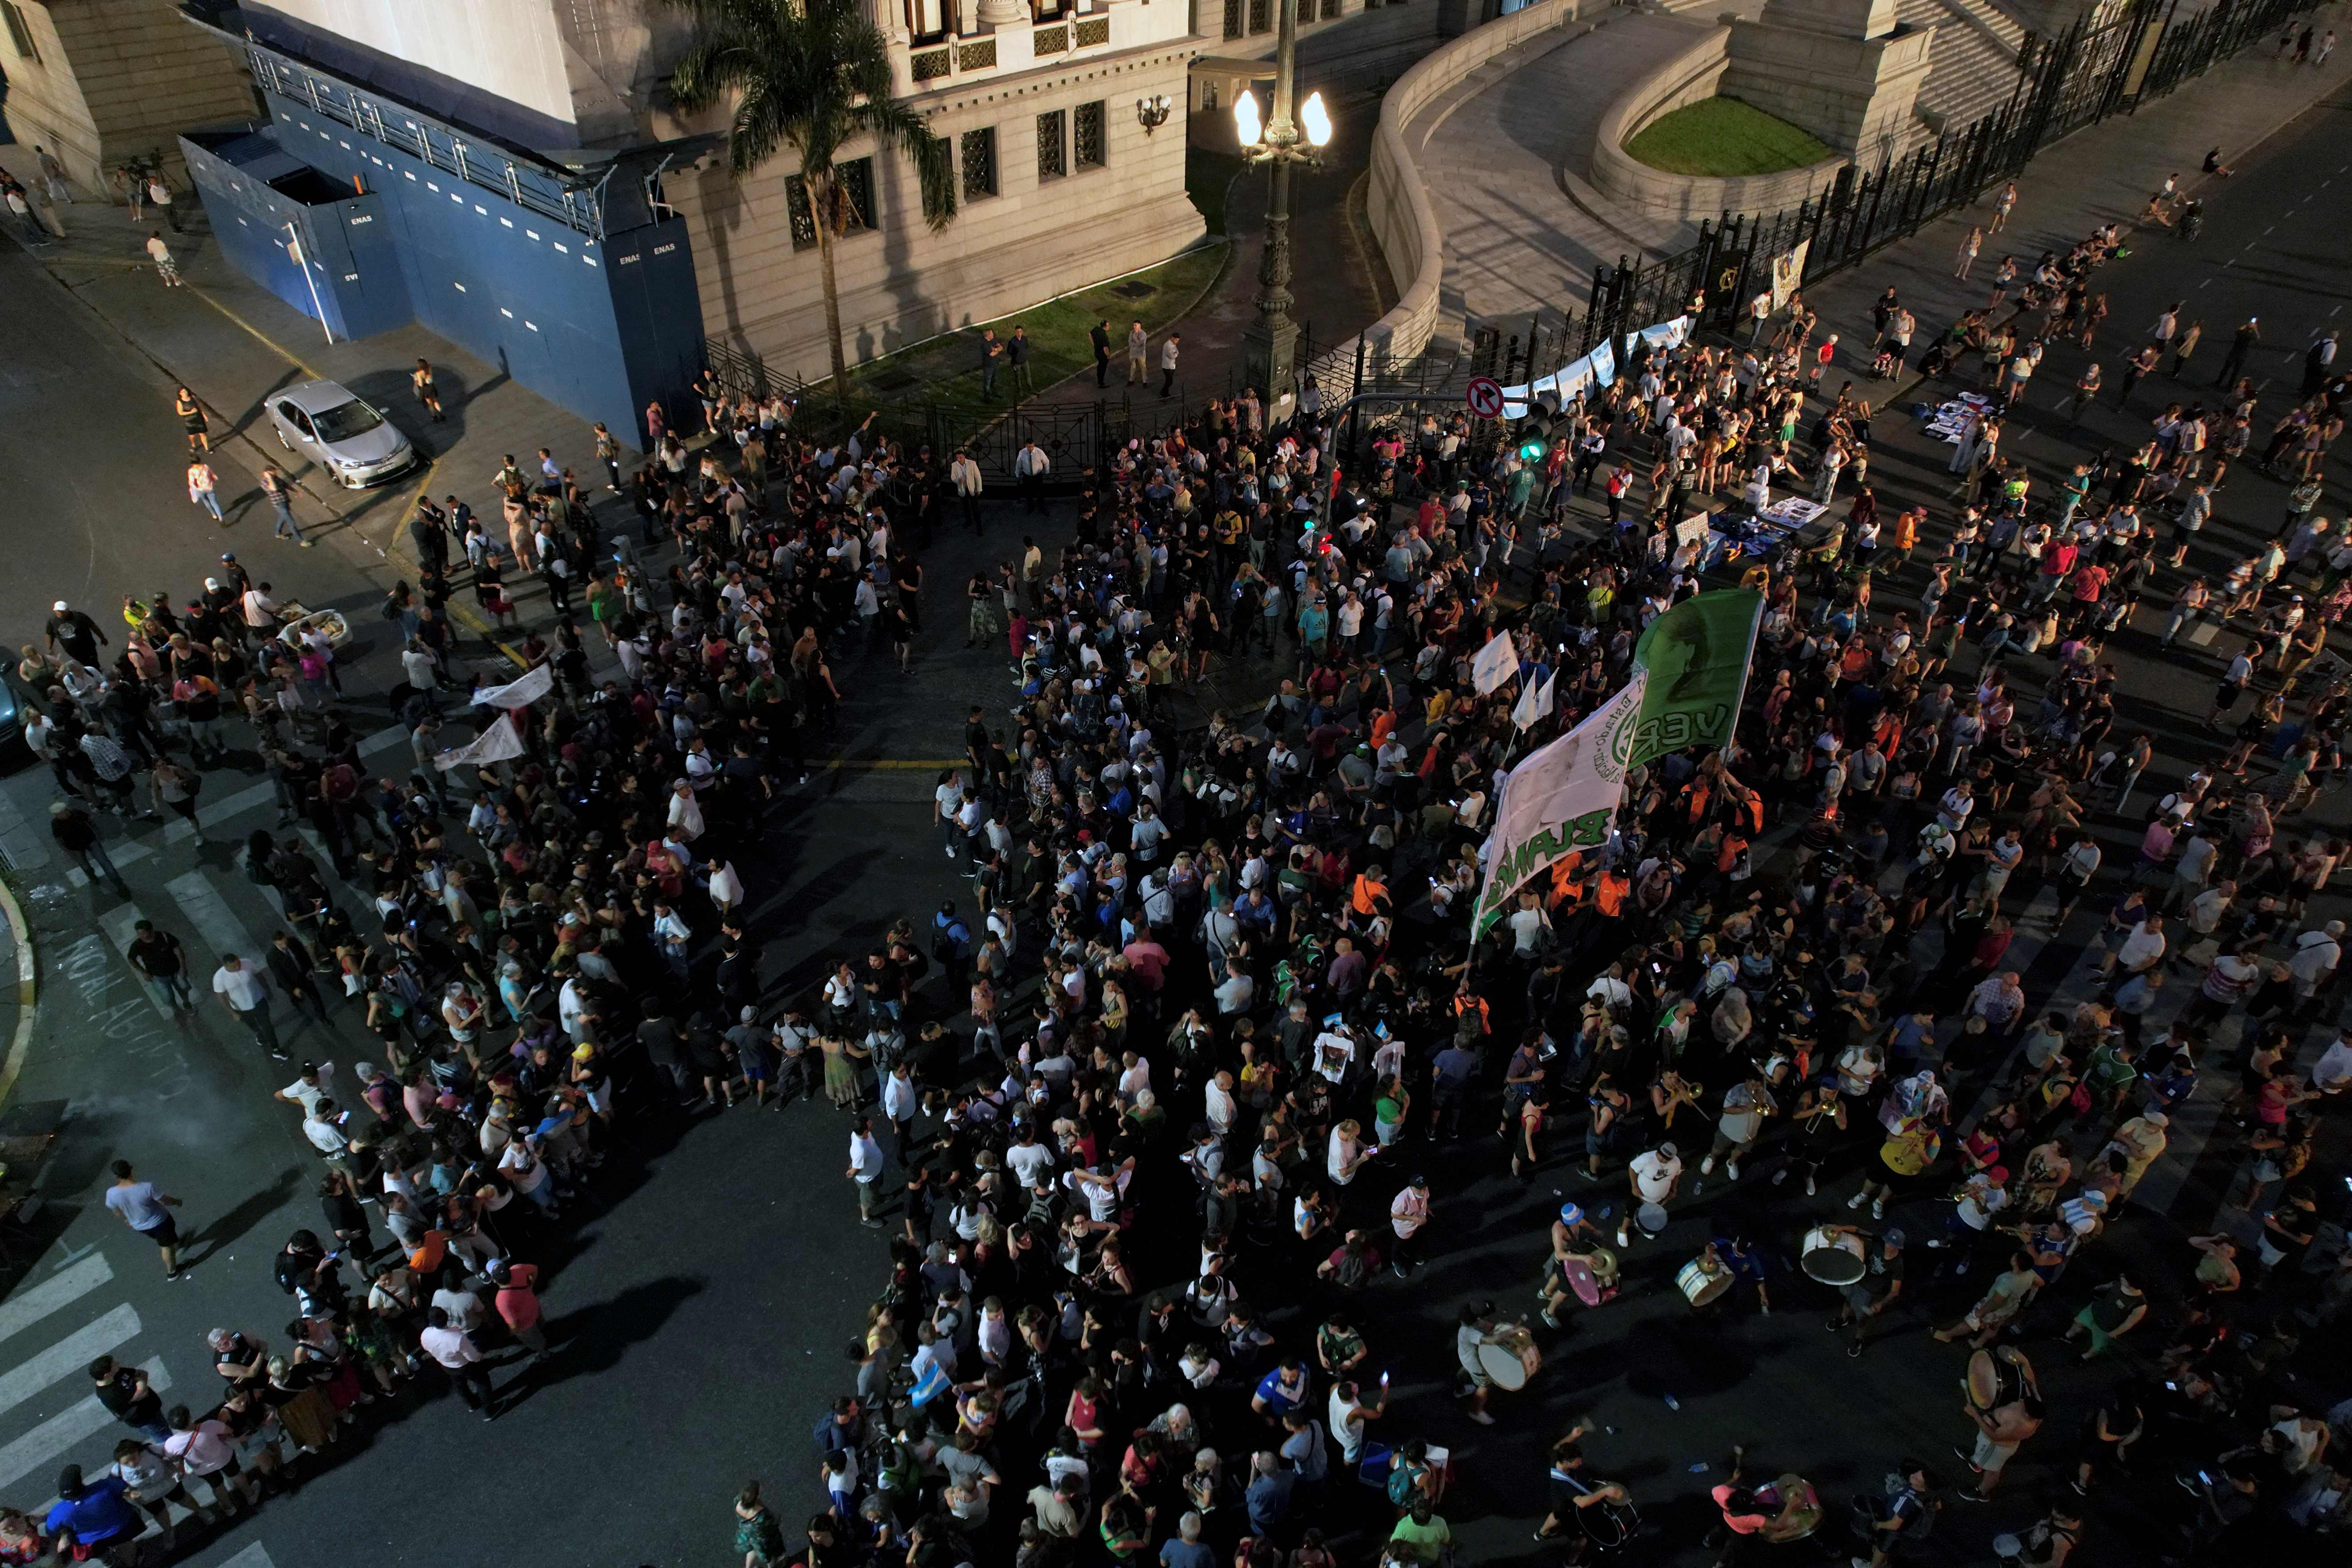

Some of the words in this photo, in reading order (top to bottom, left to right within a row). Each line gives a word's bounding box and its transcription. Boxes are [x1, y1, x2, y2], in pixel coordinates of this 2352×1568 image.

[351, 216, 372, 225] ENAS
[654, 243, 675, 255] ENAS
[619, 253, 640, 265] ENAS
[55, 934, 107, 980] NO
